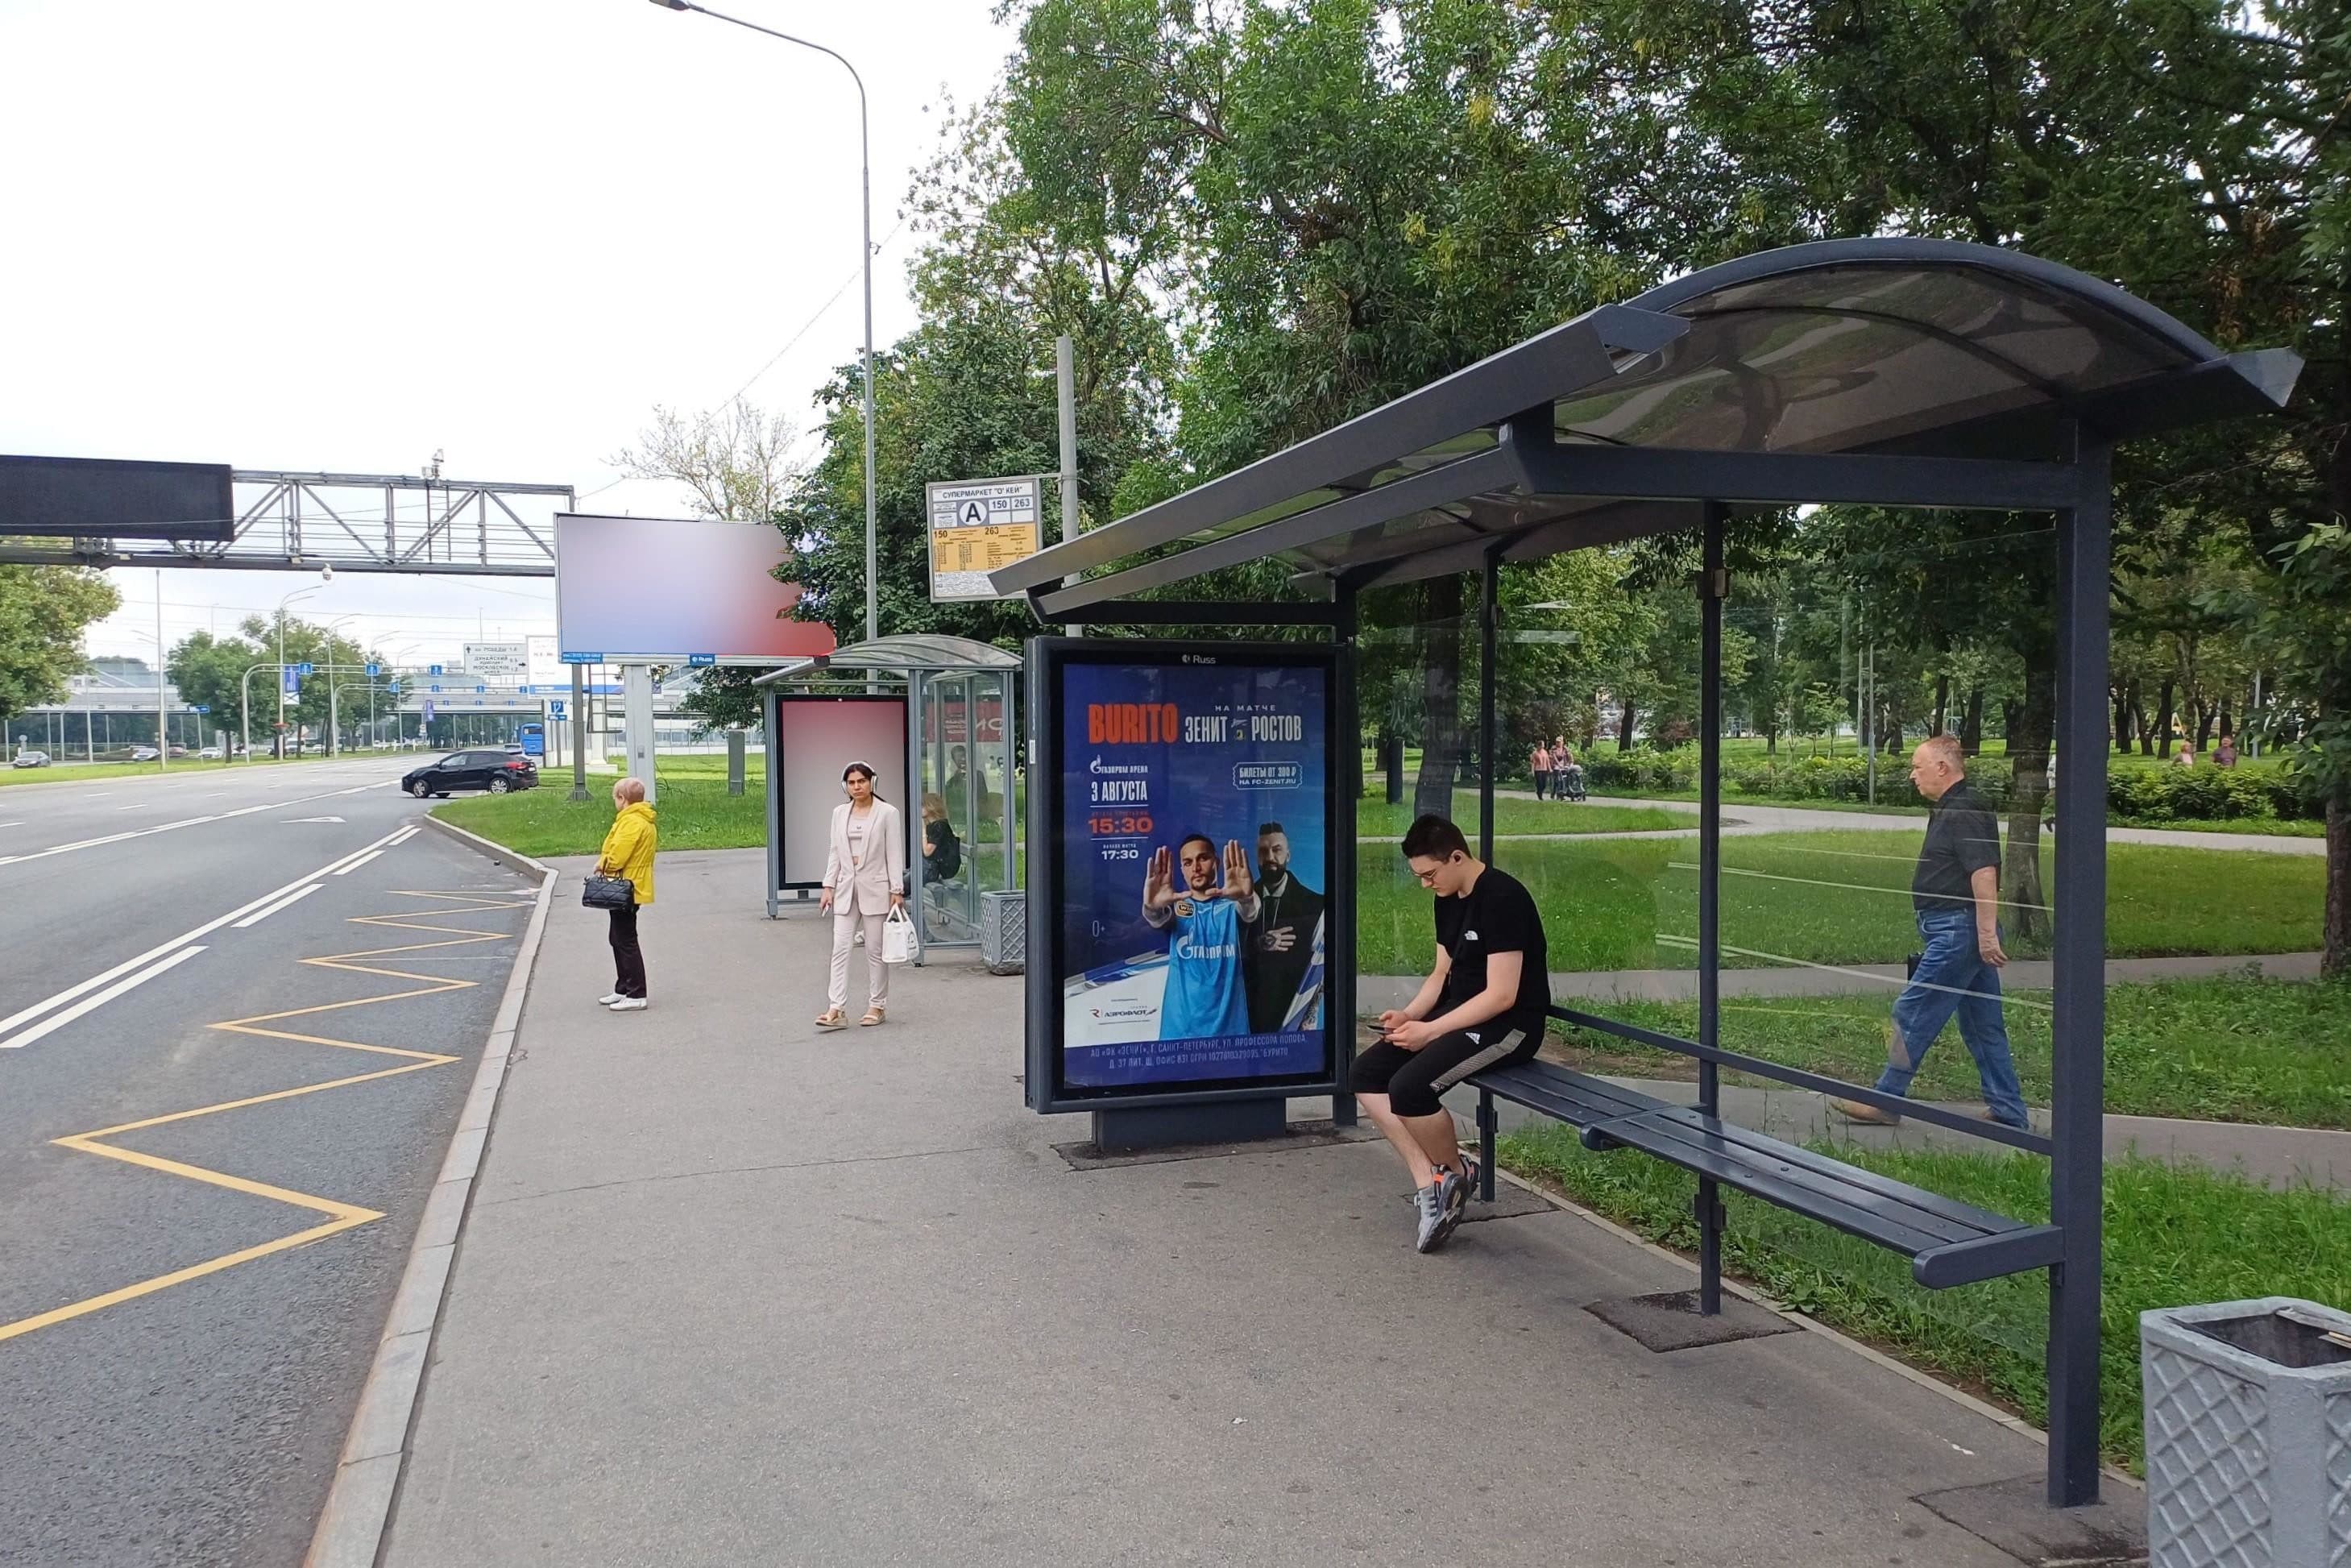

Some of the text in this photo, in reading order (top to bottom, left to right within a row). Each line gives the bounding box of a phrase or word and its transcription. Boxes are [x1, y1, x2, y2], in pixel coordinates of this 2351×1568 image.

[942, 488, 992, 499] СУПЕРМАРКЕТ
[992, 498, 1030, 509] 150 263
[965, 502, 981, 523] А
[934, 530, 948, 538] 150
[985, 526, 999, 535] 263
[1193, 654, 1217, 664] Russ
[1088, 703, 1180, 745] BURITO
[1185, 716, 1302, 743] ЗЕНИТ РОСТОВ
[1239, 767, 1267, 778] БИЛЕТЫ
[1267, 766, 1276, 778] ОТ
[1091, 780, 1148, 802] 3 АВГУСТА
[1088, 816, 1154, 834] 15:30
[1101, 849, 1139, 860] 17:30
[1104, 1010, 1147, 1018] АЭРОФЛОТ
